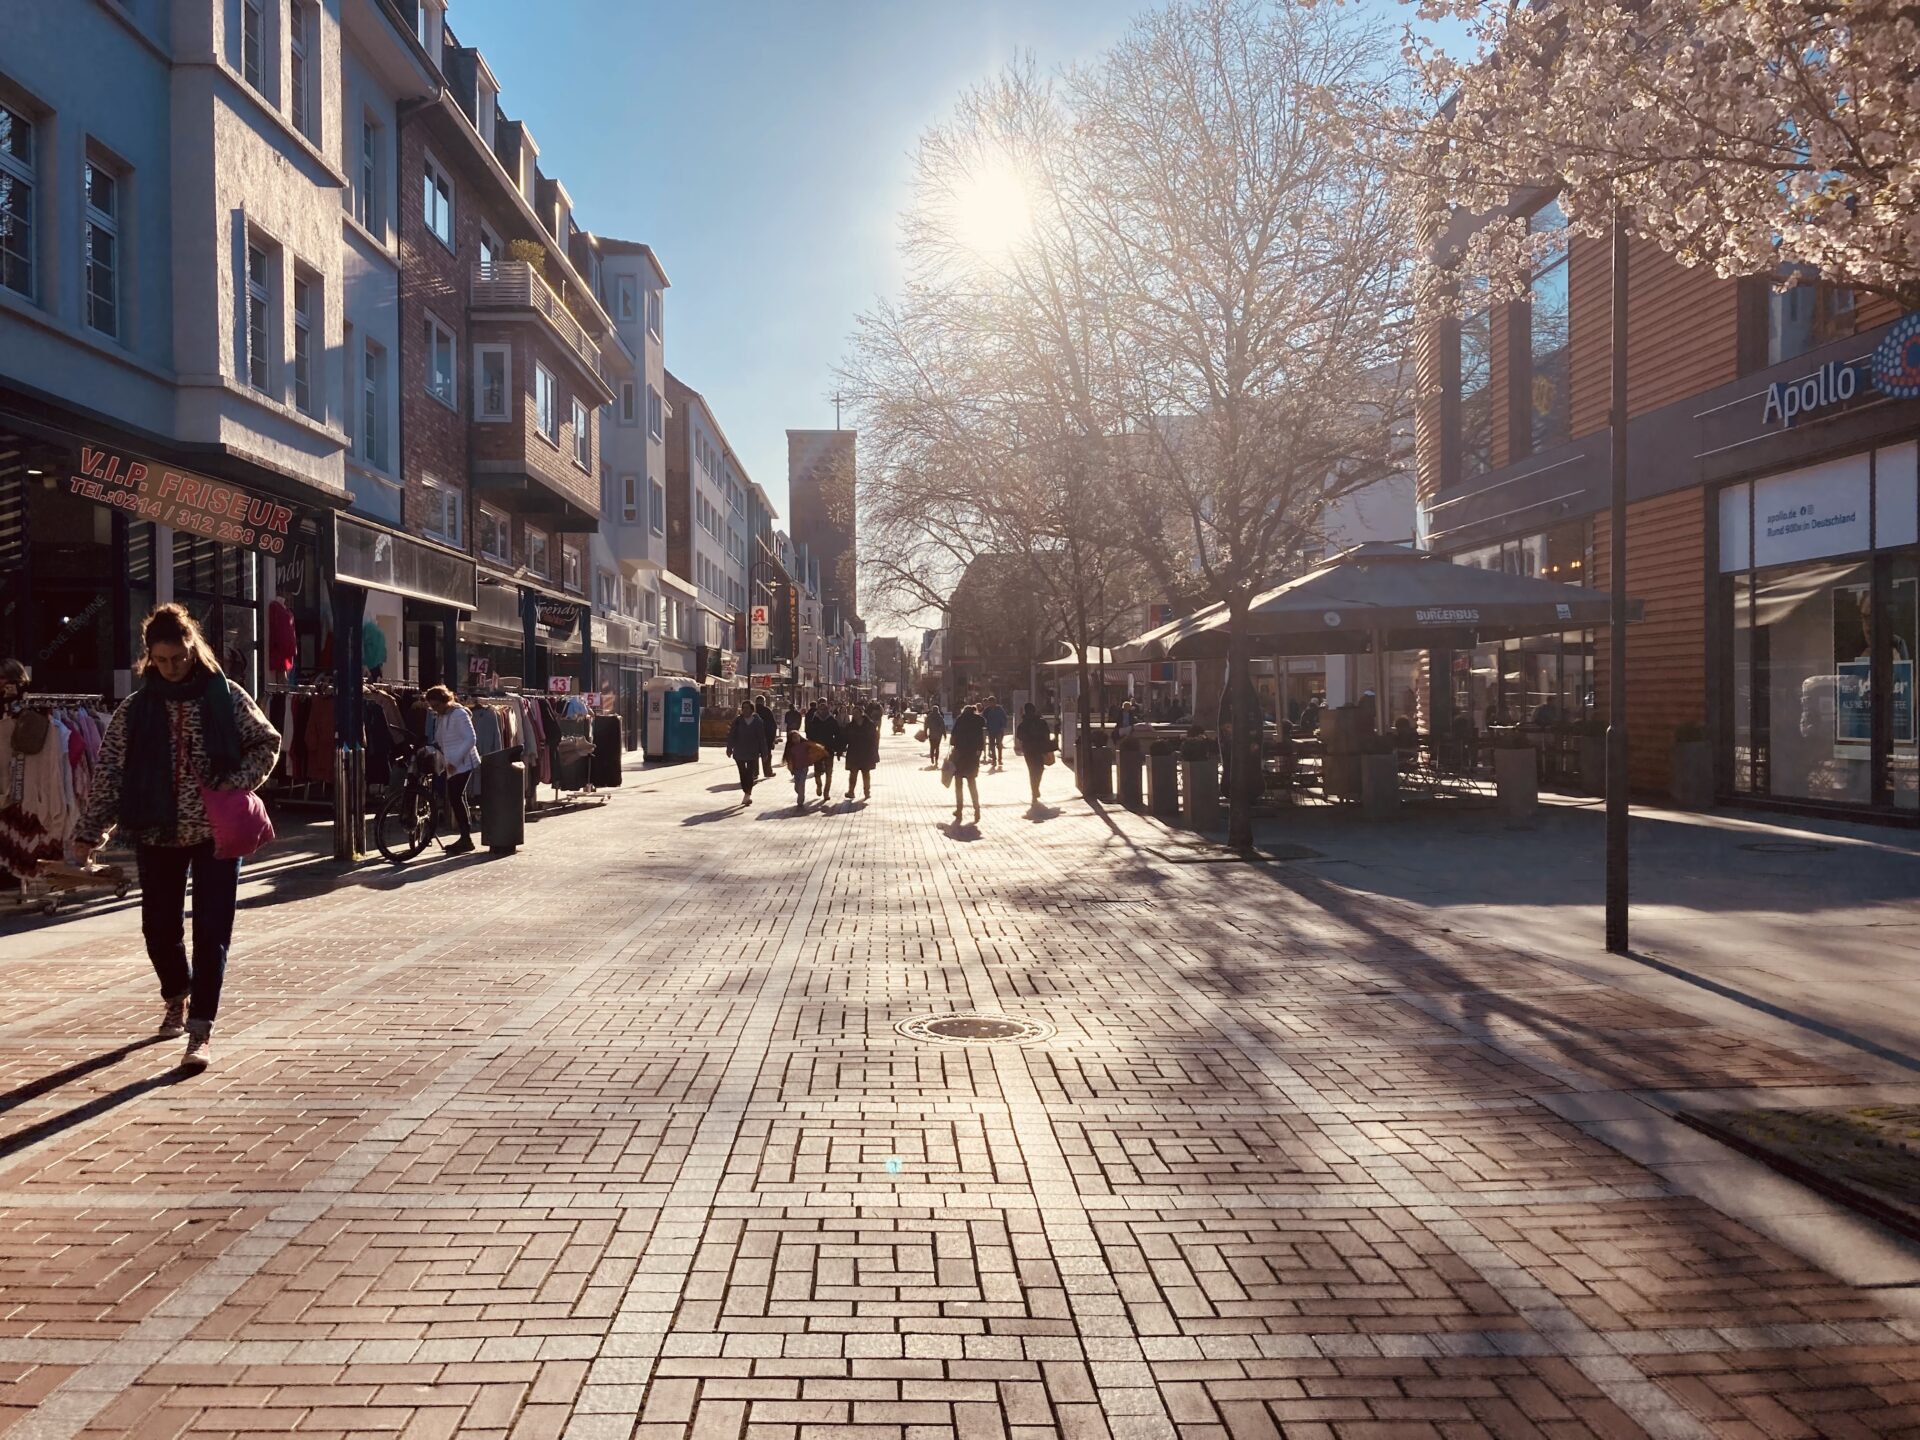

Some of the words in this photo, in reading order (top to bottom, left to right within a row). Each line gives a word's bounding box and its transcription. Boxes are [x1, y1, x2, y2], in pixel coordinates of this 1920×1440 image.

[1762, 361, 1856, 428] Apollo
[80, 446, 149, 492] V.I.P.
[157, 471, 294, 535] FRISEUR
[163, 505, 176, 521] /
[176, 508, 215, 533] 312
[216, 521, 256, 545] 268
[258, 533, 286, 555] 90
[1766, 525, 1785, 537] Rund
[1811, 511, 1856, 529] Deutschland
[1767, 510, 1797, 525] apollo.de
[276, 543, 305, 597] ndy
[535, 601, 580, 622] Trendy
[752, 607, 766, 622] A
[1415, 609, 1480, 622] BURGERBUS
